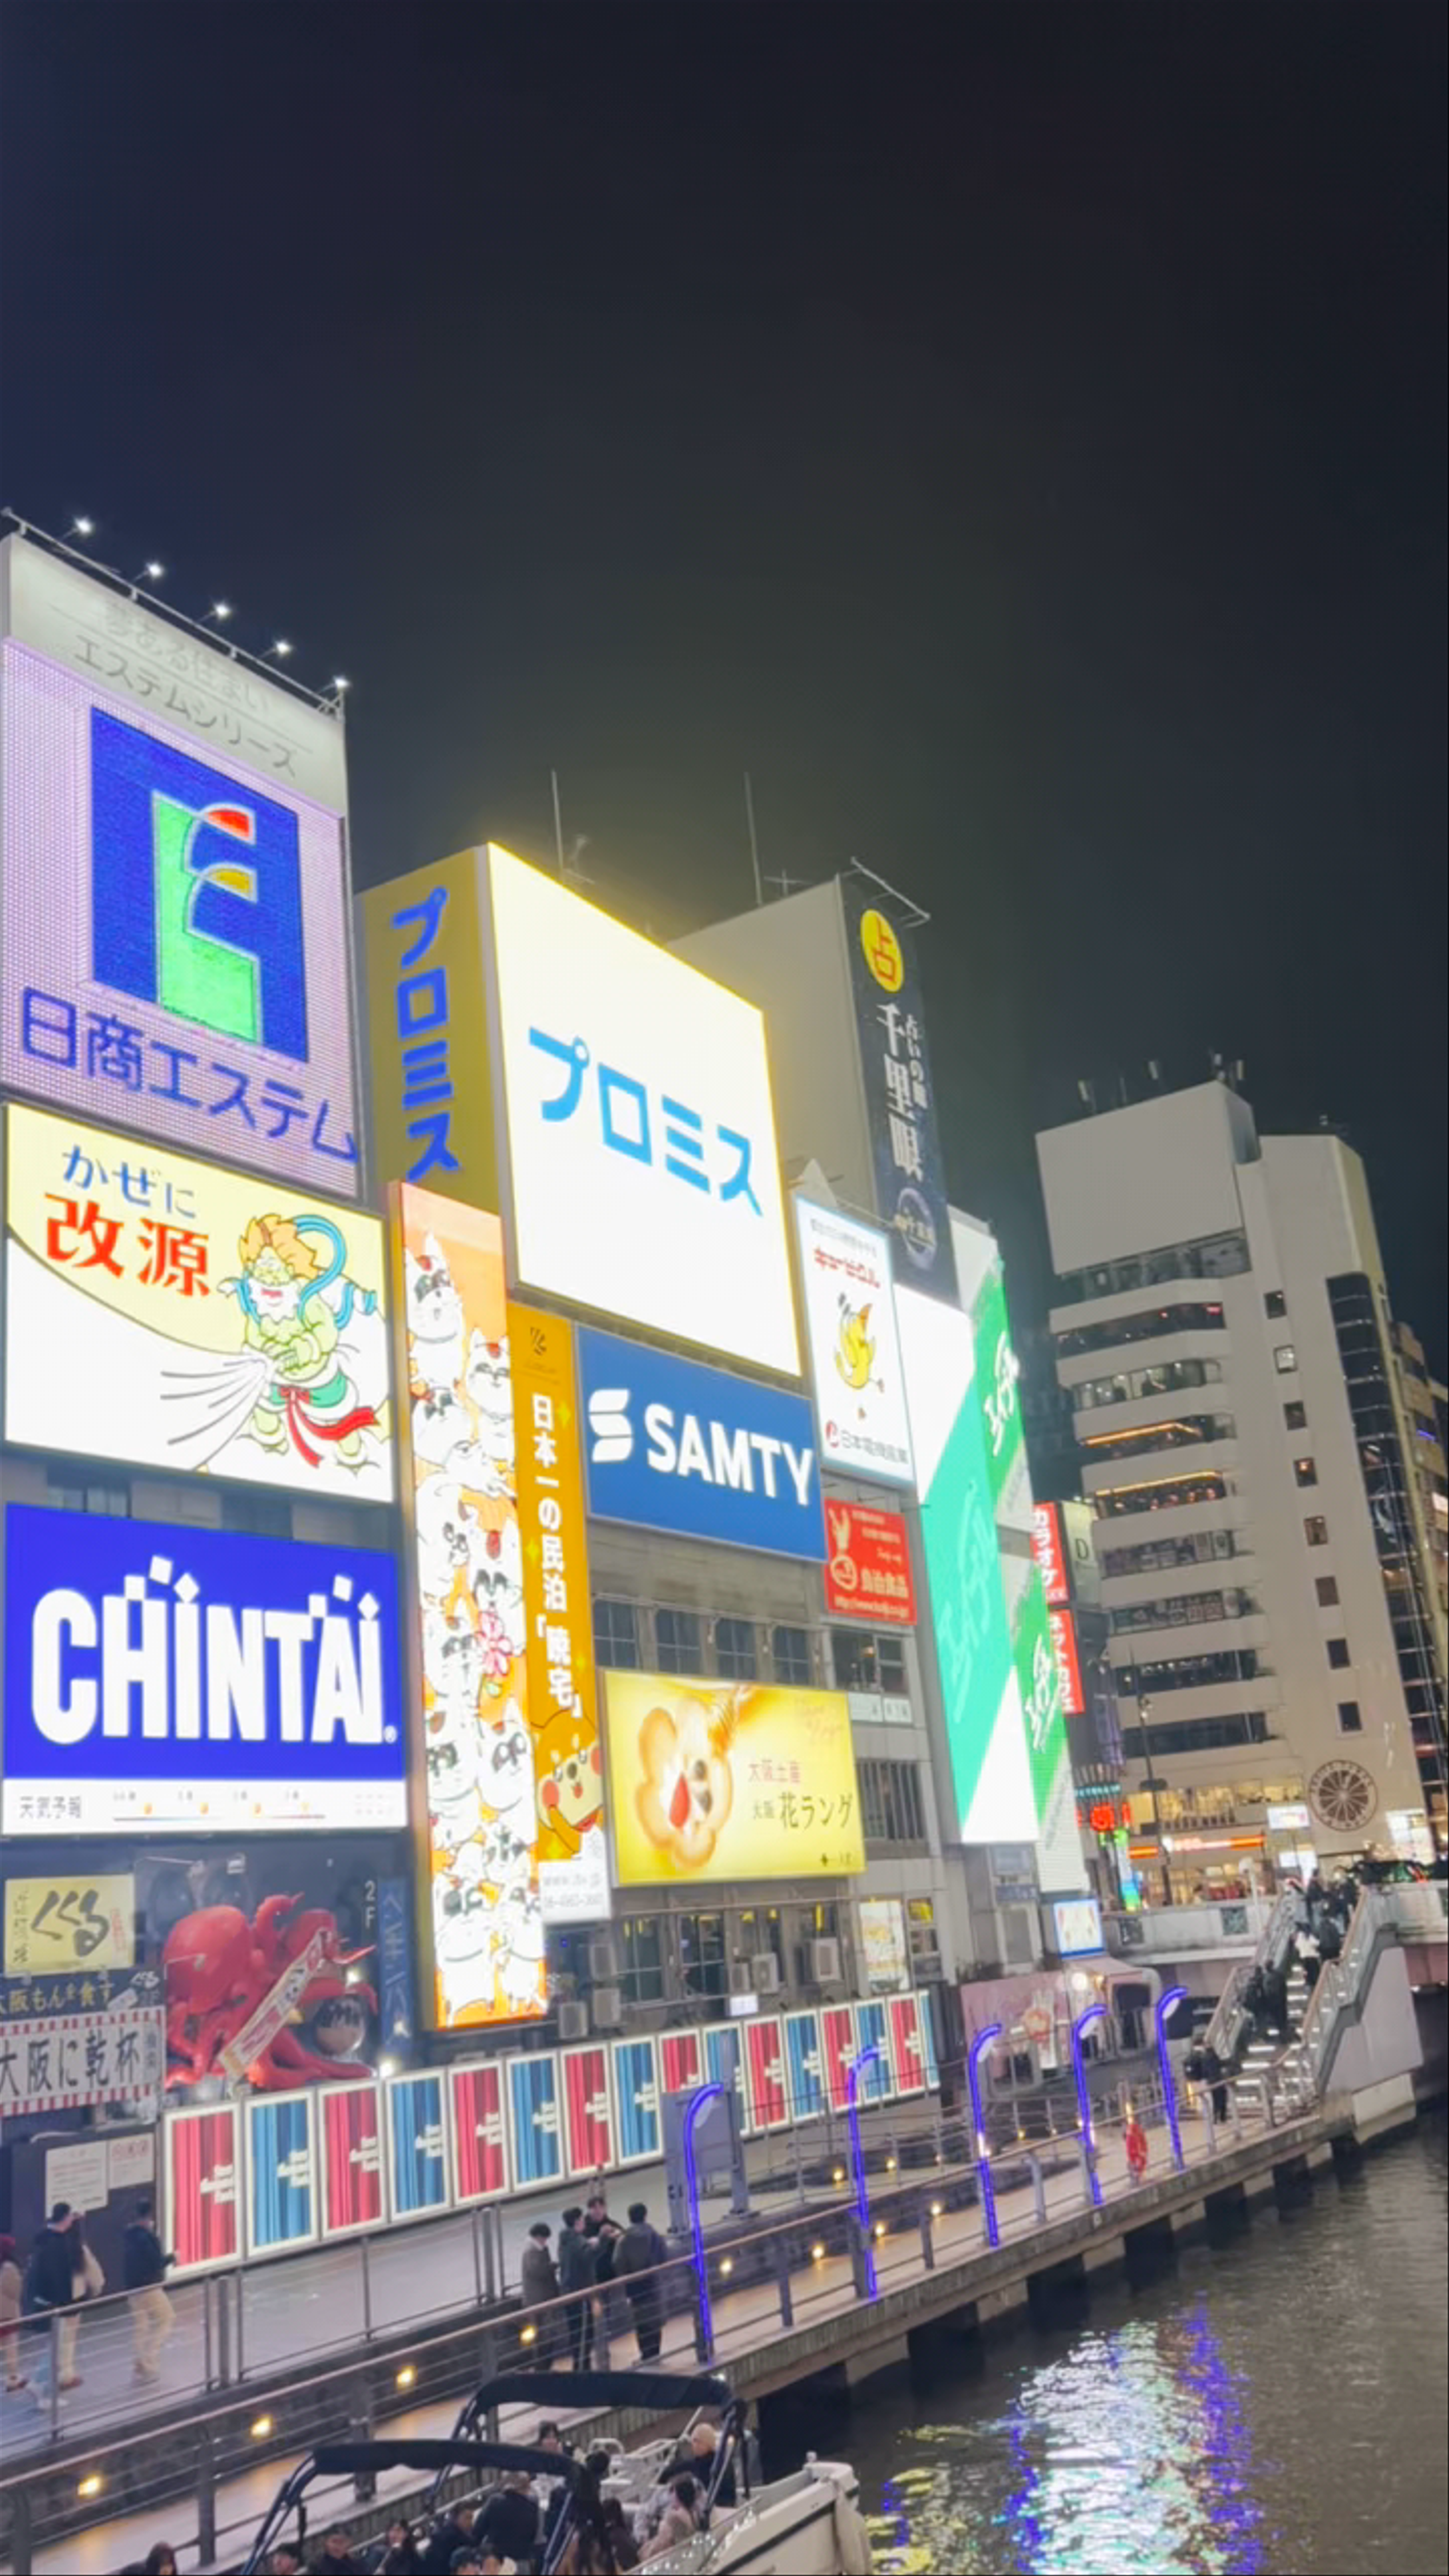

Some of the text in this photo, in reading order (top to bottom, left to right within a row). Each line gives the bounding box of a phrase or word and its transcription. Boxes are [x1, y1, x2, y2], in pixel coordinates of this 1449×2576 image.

[23, 986, 359, 1163] 日商エステム
[392, 885, 460, 1183] プロミス
[63, 1145, 197, 1219] かぜに
[529, 1026, 763, 1216] プロミス
[45, 1192, 210, 1297] 改源
[644, 1403, 812, 1507] SAMTY
